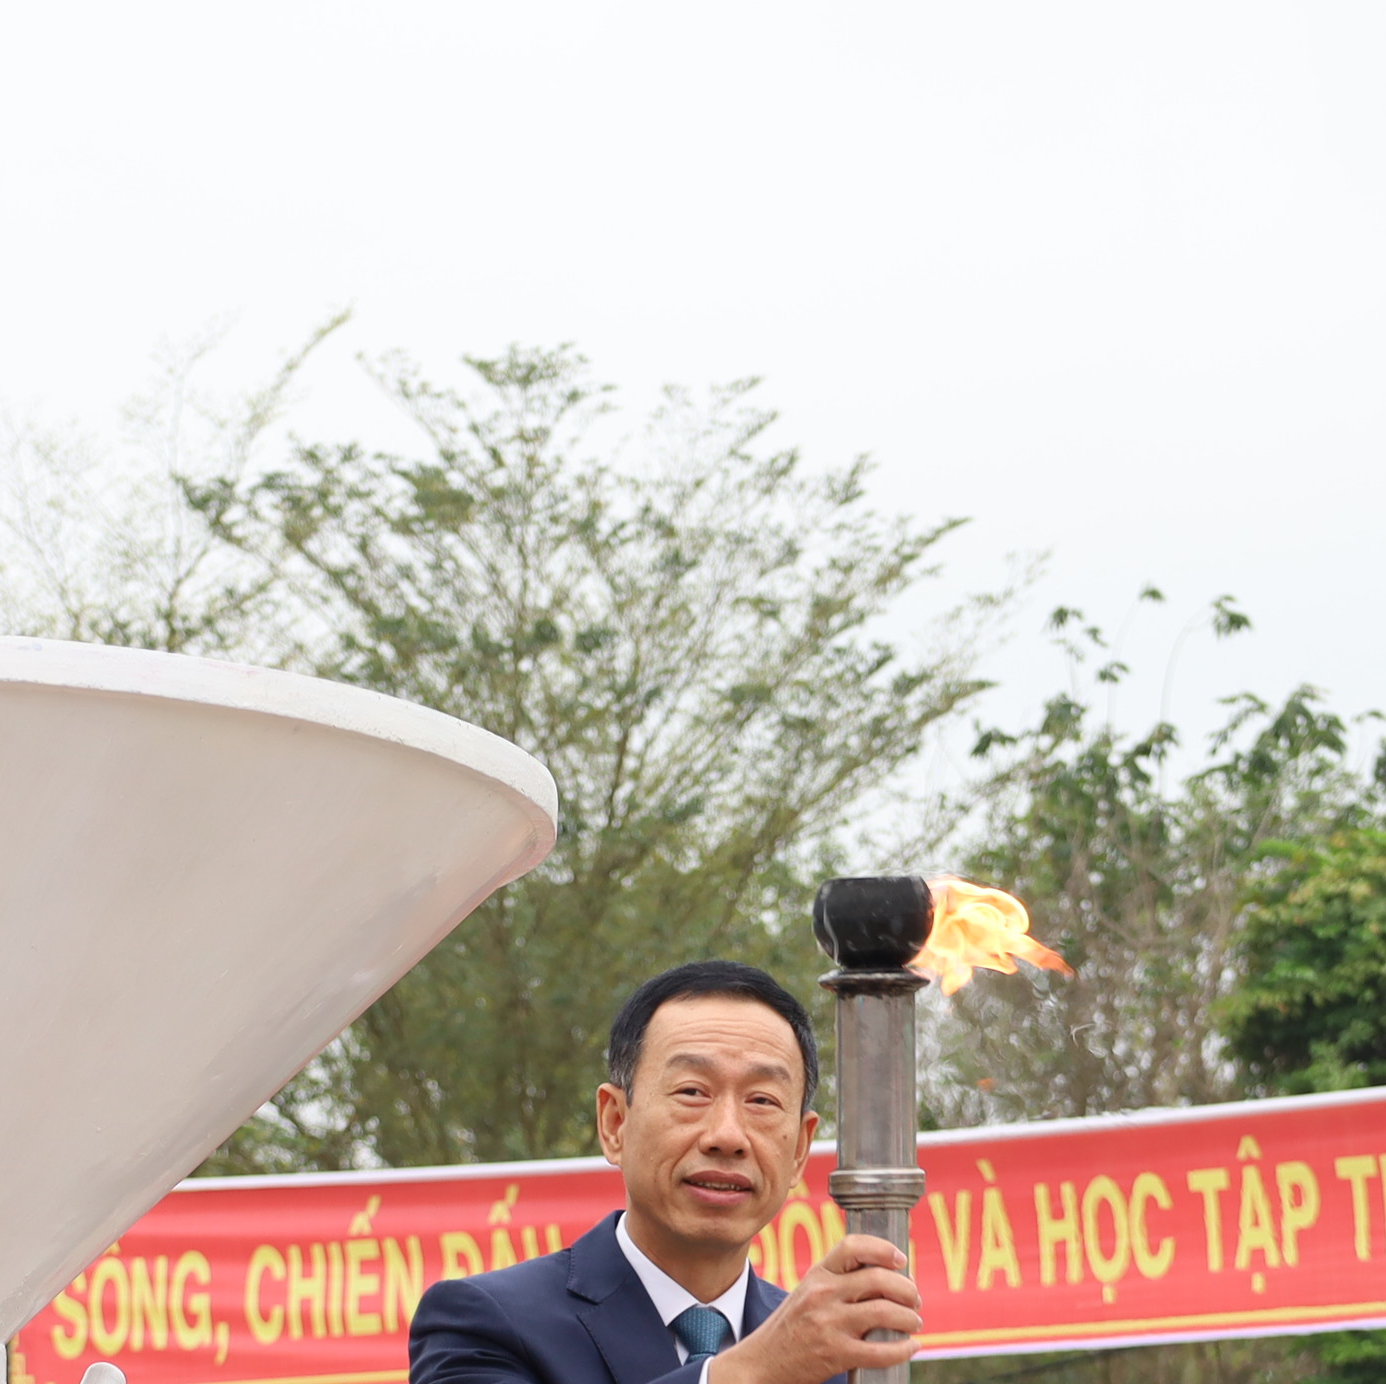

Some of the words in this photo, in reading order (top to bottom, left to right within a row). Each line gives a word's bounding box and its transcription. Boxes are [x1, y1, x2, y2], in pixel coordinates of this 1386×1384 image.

[245, 1195, 425, 1344] CHIẾN
[929, 1160, 1020, 1291] VÀ
[1035, 1172, 1176, 1304] HỌC
[1188, 1136, 1320, 1295] TẬP
